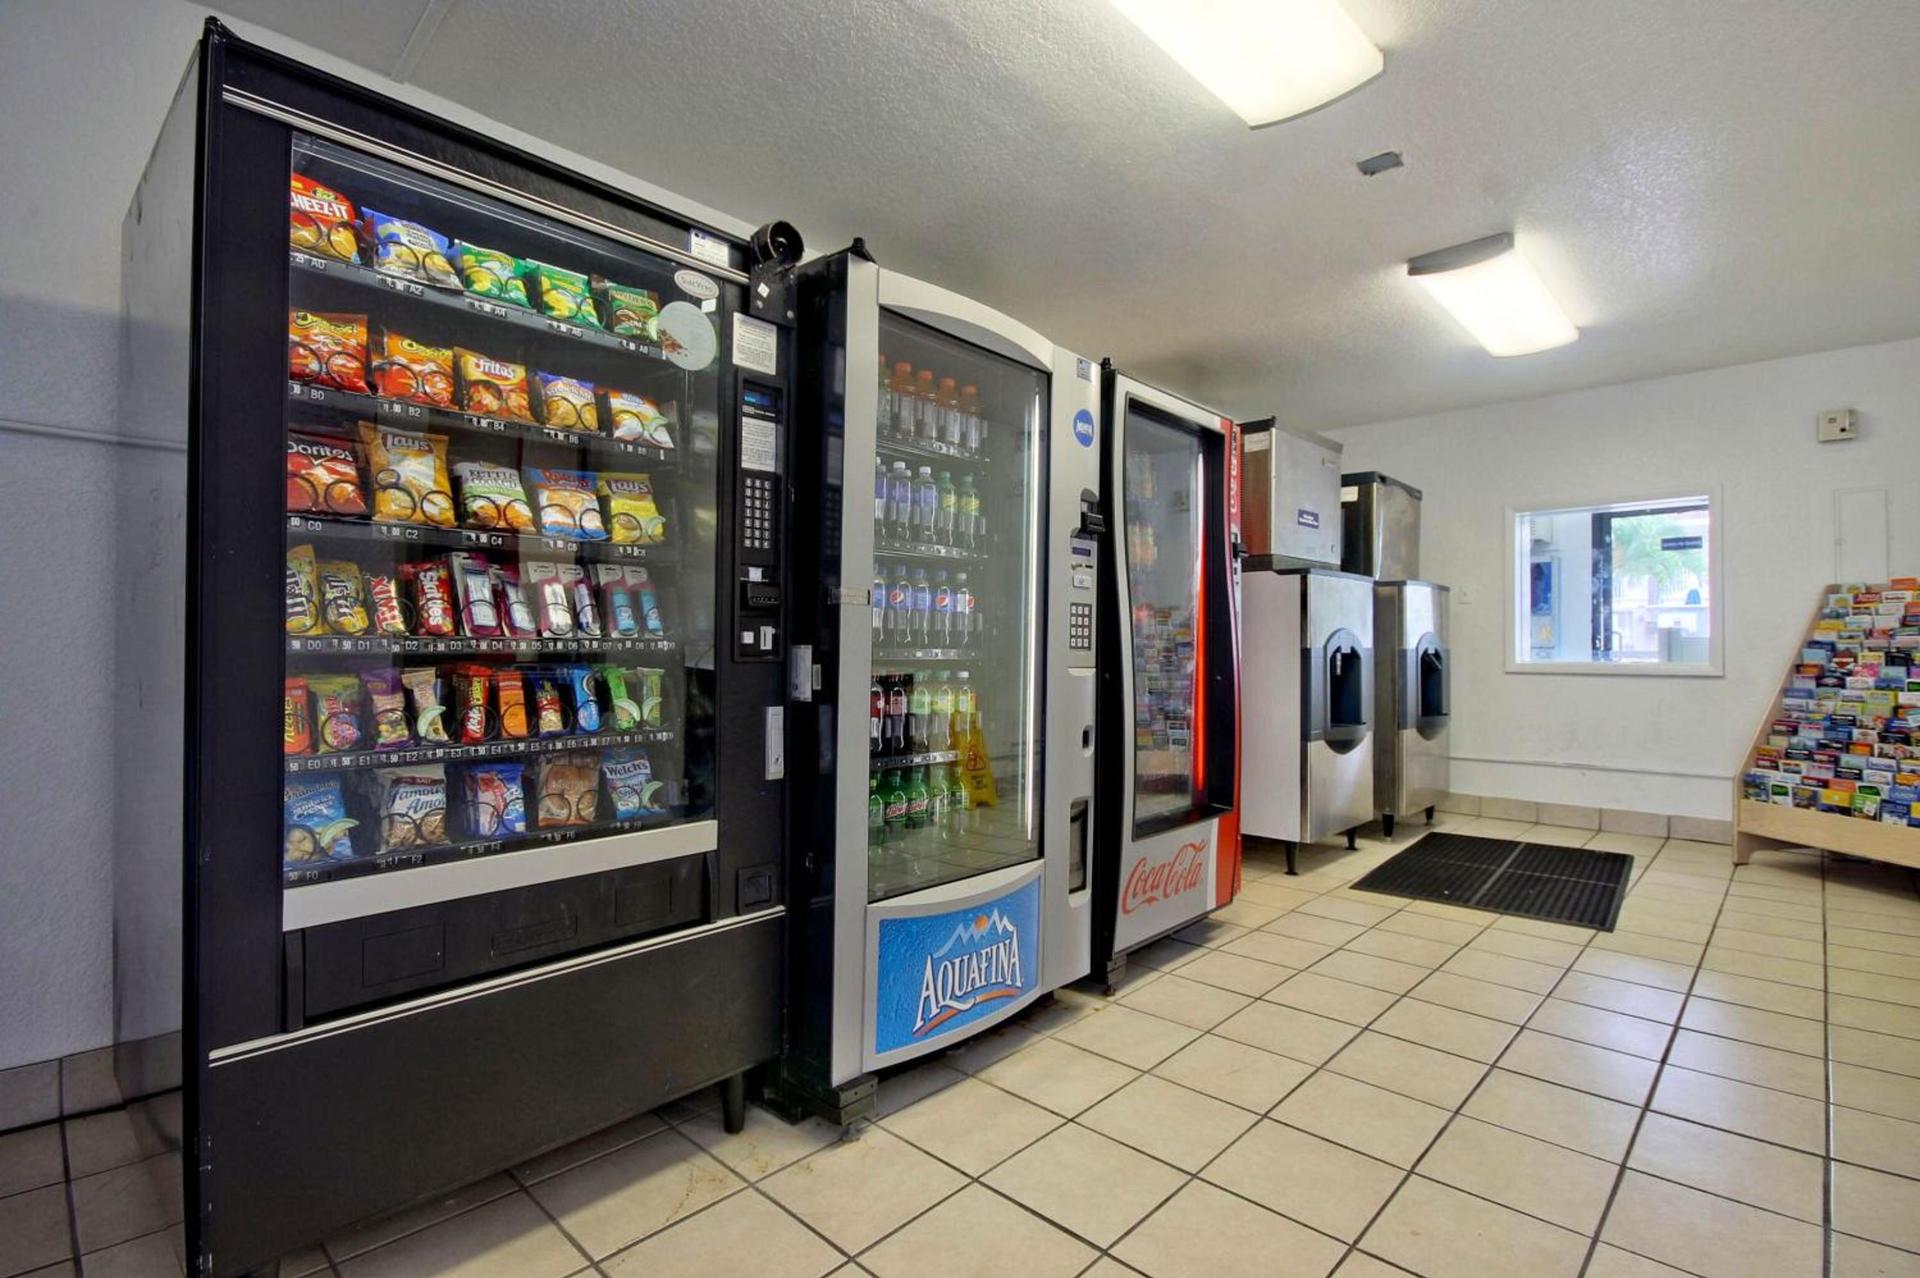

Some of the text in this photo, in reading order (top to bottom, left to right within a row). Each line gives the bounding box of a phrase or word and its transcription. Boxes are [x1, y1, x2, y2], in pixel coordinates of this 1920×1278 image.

[291, 191, 348, 220] HEEZ-IT
[405, 529, 418, 539] C2
[604, 761, 649, 778] Welch's
[1121, 841, 1208, 915] Coca-Cola
[912, 927, 1023, 1032] AQUAFINA
